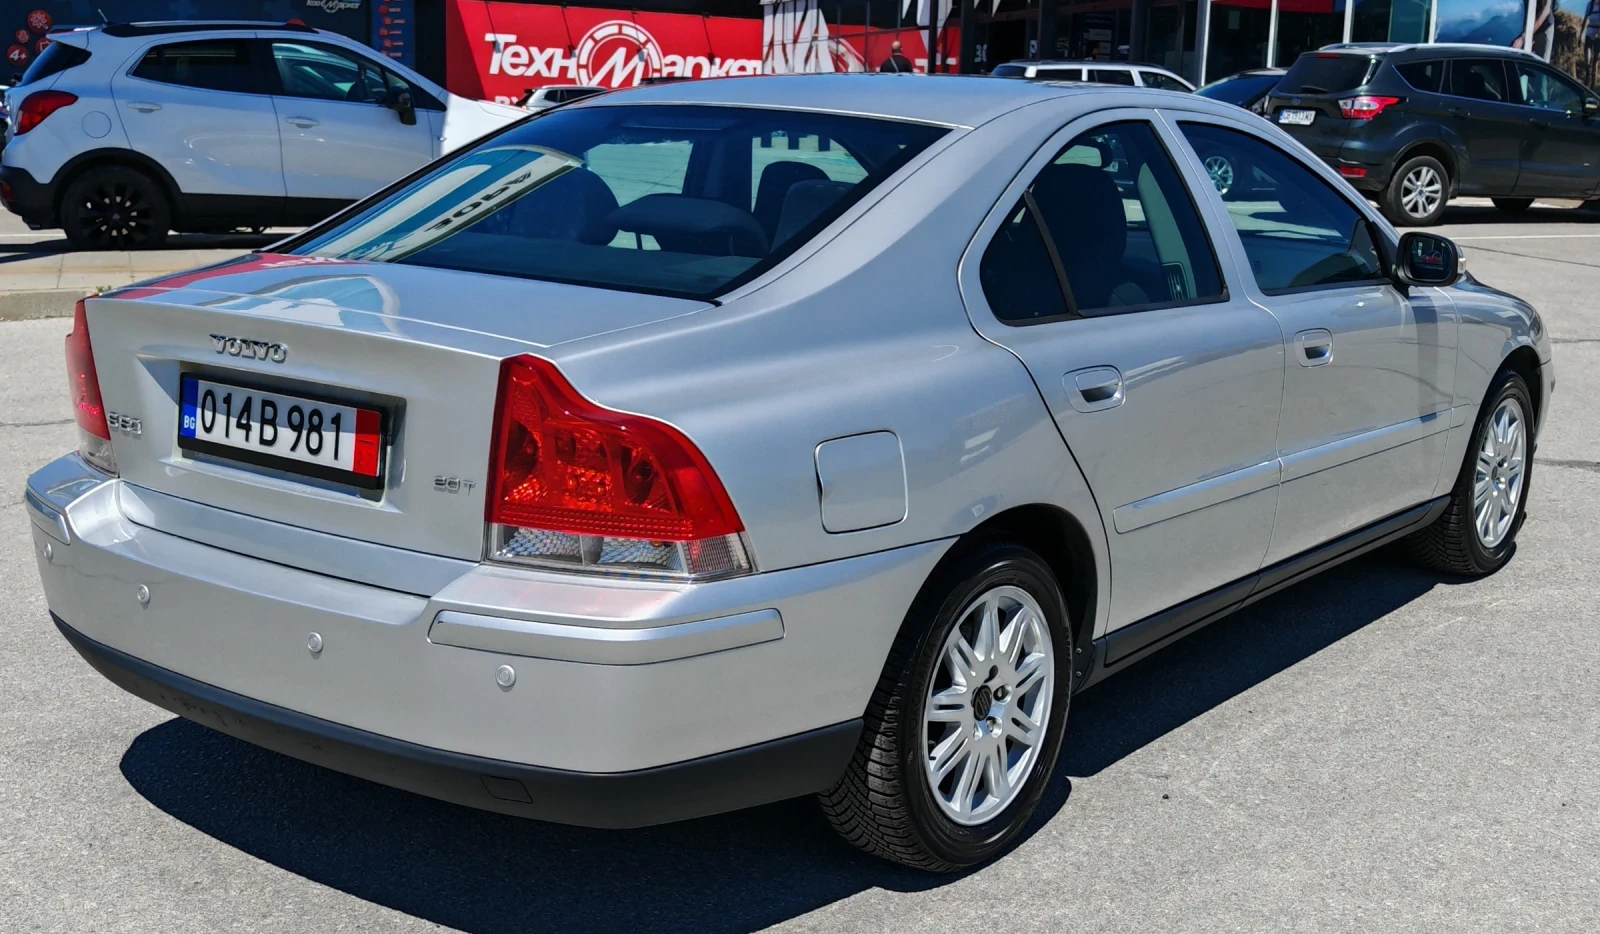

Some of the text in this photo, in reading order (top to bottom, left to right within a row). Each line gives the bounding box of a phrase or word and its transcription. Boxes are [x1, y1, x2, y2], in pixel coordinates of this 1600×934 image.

[210, 333, 288, 363] VOLVO
[108, 411, 142, 435] S60
[184, 414, 195, 430] BG
